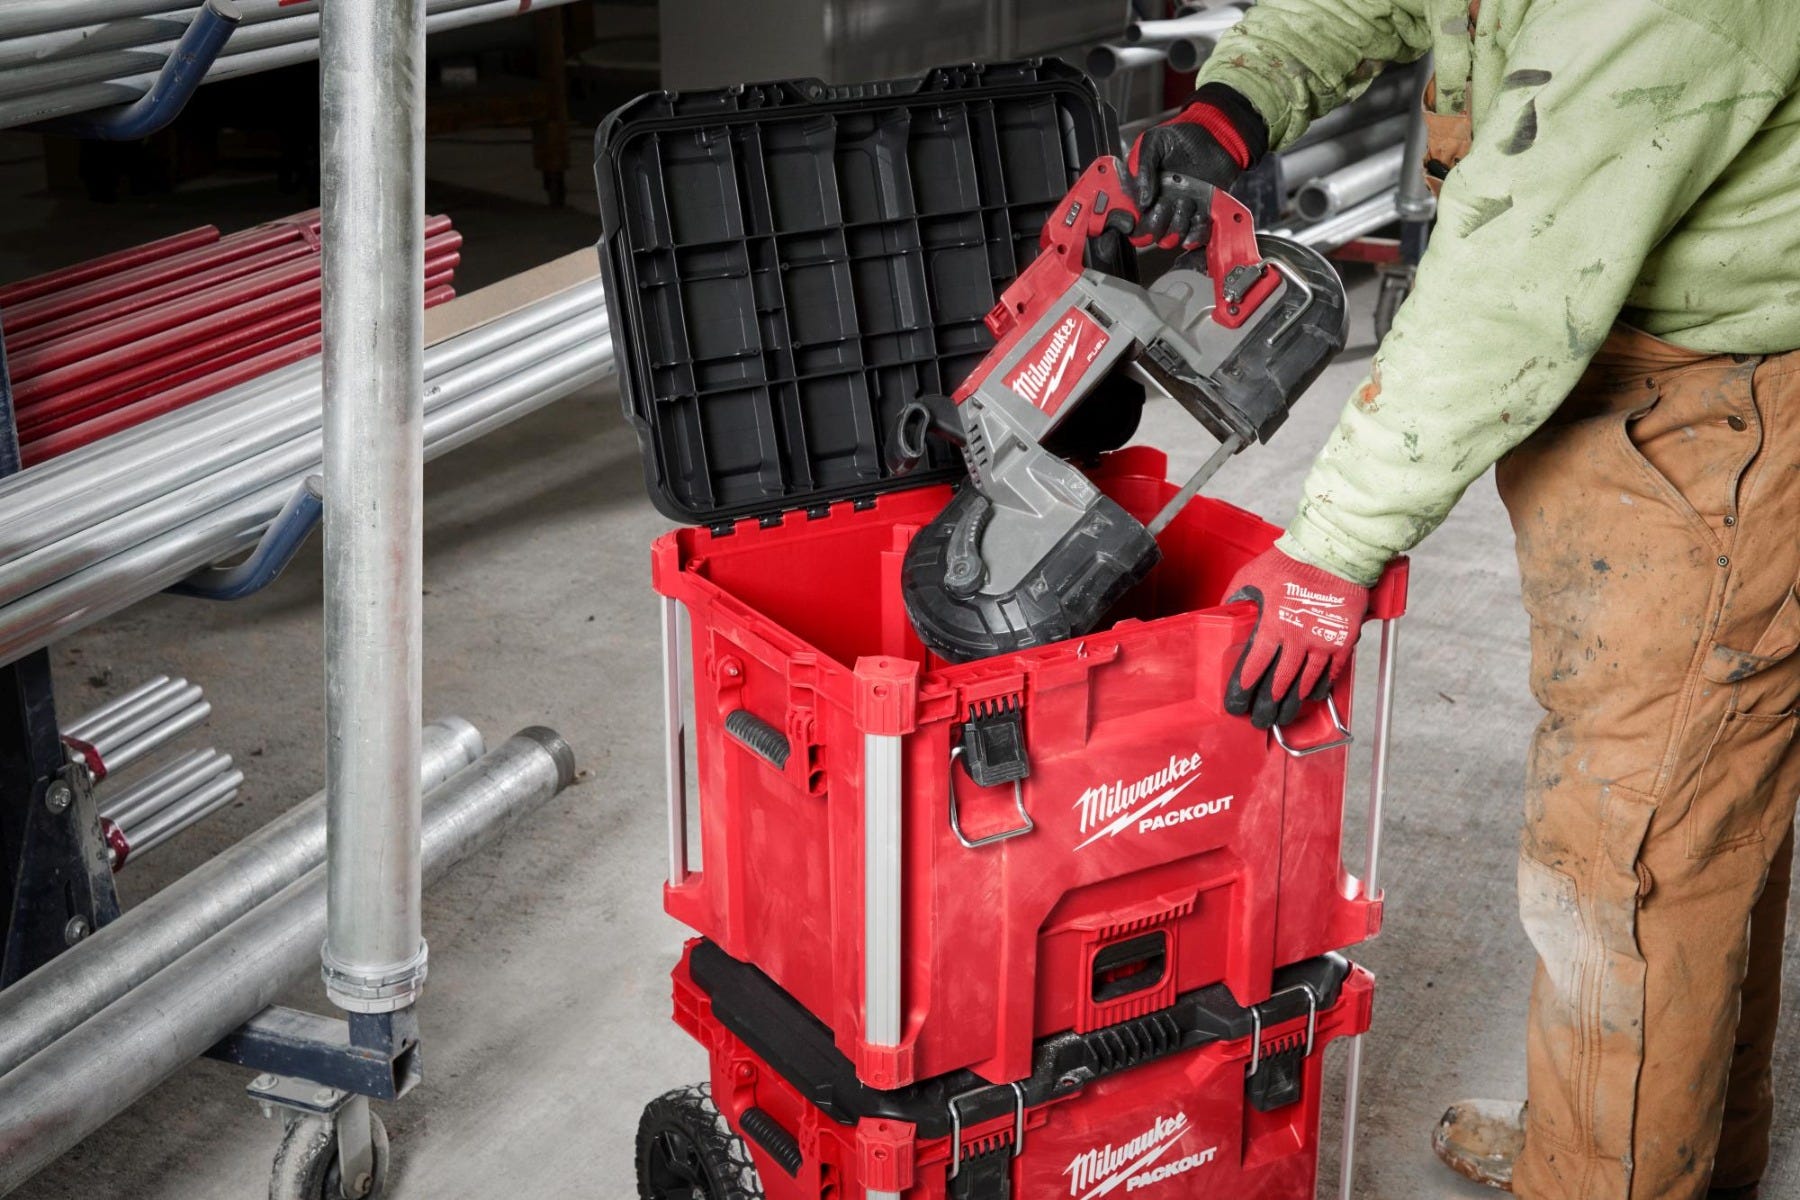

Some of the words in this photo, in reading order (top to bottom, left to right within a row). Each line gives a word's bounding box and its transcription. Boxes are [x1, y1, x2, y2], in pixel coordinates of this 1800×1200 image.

[1013, 318, 1077, 404] Milwaukee
[1087, 339, 1106, 362] FUEL
[1282, 582, 1345, 604] Milwaukee
[1072, 752, 1202, 834] Milwaukee
[1139, 795, 1234, 834] PACKOUT
[1062, 1111, 1188, 1197] Milwaukee
[1126, 1146, 1218, 1193] PACKOUT
